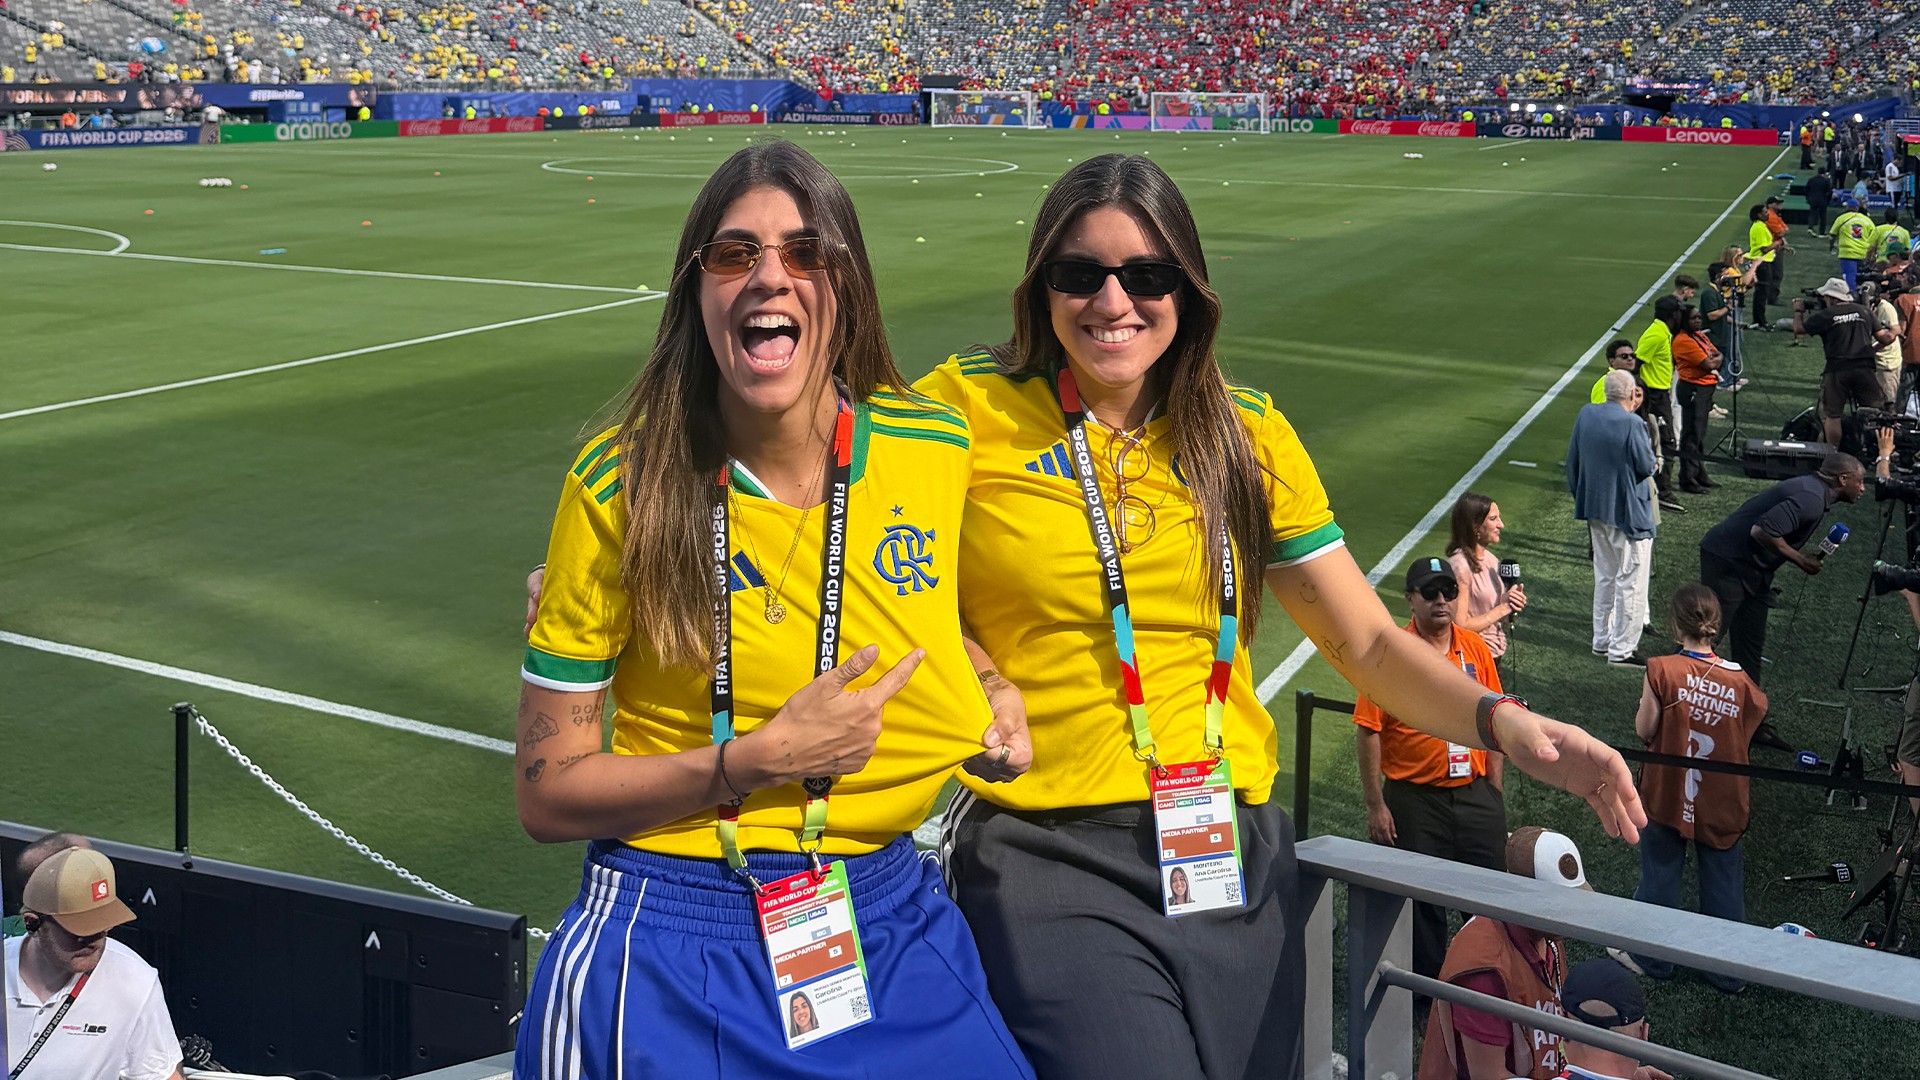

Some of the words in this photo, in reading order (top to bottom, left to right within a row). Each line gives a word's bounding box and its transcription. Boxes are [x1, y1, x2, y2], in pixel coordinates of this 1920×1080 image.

[77, 89, 126, 104] JERSY
[594, 116, 630, 127] HYUNDAI
[674, 114, 705, 125] Lenovo
[717, 112, 750, 124] Lenovo
[783, 113, 805, 123] ADI
[806, 114, 871, 123] PREDICTSTREET
[40, 132, 69, 146] FIFA
[70, 131, 117, 146] WORLD
[117, 130, 142, 143] CUP
[143, 129, 186, 143] 2026
[275, 122, 352, 140] aramco
[1666, 128, 1732, 144] Lenovo
[1072, 428, 1093, 474] 2026
[832, 482, 846, 517] FIFA
[1084, 477, 1100, 503] CUP
[712, 505, 725, 561] 2026
[1093, 506, 1115, 558] WORLD
[828, 519, 843, 577] WORLD
[1105, 558, 1122, 591] FIFA
[825, 579, 839, 612] CUP
[820, 614, 836, 671] 2026
[716, 661, 729, 695] FIFA
[1686, 673, 1736, 701] MEDIA
[1678, 688, 1740, 719] PARTNER
[1169, 777, 1191, 786] WORLD
[1204, 773, 1225, 781] 2026
[1172, 789, 1201, 798] TOURNAMENT
[1161, 830, 1181, 838] MEDIA
[1181, 826, 1209, 836] PARTNER
[1194, 860, 1223, 869] MONTEIRO
[1207, 867, 1232, 876] Carolina
[763, 899, 778, 909] FIFA
[778, 891, 802, 904] WORLD
[802, 887, 816, 896] CUP
[816, 878, 840, 891] 2026
[782, 901, 815, 917] TOURNAMENT
[775, 951, 797, 964] MEDIA
[797, 941, 827, 957] PARTNER
[815, 985, 842, 999] Carolina
[26, 1036, 45, 1059] WORLD
[43, 1024, 54, 1038] CUP
